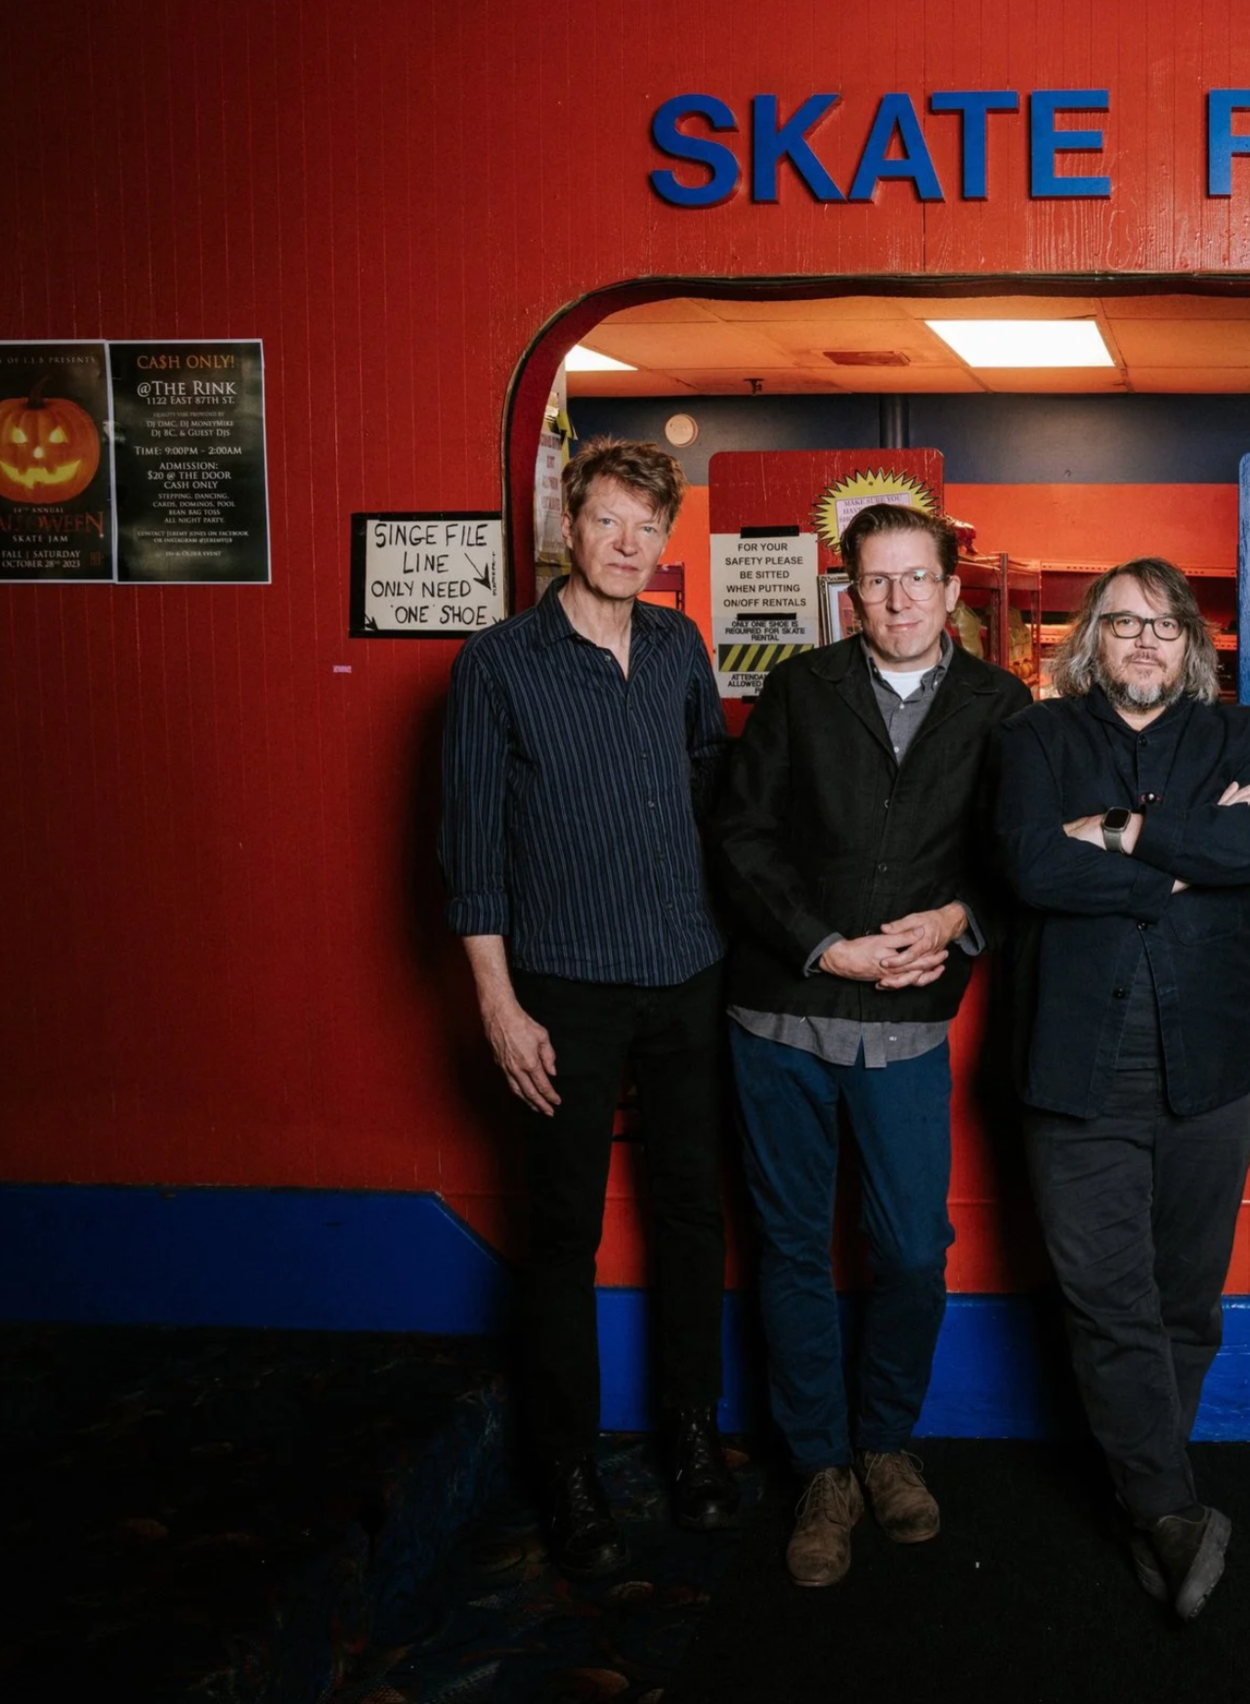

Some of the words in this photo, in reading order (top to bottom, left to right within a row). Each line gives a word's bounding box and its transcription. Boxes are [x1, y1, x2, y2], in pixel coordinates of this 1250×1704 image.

[650, 90, 1111, 207] SKATE
[49, 356, 96, 364] PRESENTS
[186, 355, 235, 369] ONLY!
[146, 396, 167, 405] 1122
[170, 396, 193, 405] EAST
[195, 396, 219, 405] 87TH
[165, 446, 199, 455] 9:00PM
[208, 446, 242, 455] 2:00AM
[160, 462, 219, 470] ADMISSION:
[148, 470, 164, 480] $20
[179, 470, 198, 480] THE
[202, 470, 232, 480] DOOR
[164, 481, 190, 490] CASH
[192, 481, 219, 490] ONLY
[0, 511, 105, 535] ALLOWEEN
[12, 535, 42, 544] SKATE
[48, 535, 69, 544] JAM
[374, 524, 438, 547] SINGE
[446, 524, 488, 547] FILE
[738, 543, 758, 552] FOR
[760, 543, 788, 552] YOUR
[2, 550, 22, 558] FALL
[33, 550, 81, 558] SATURDAY
[2, 560, 43, 568] OCTOBER
[62, 560, 81, 568] 2023
[404, 552, 449, 574] LINE
[725, 558, 762, 566] SAFETY
[766, 556, 804, 565] PLEASE
[740, 571, 753, 579] BE
[756, 571, 790, 579] SITTED
[371, 580, 414, 598] ONLY
[422, 580, 471, 598] NEED
[726, 585, 756, 593] WHEN
[758, 584, 800, 592] PUTTING
[724, 599, 760, 607] ON/OFF
[762, 598, 806, 606] RENTALS
[440, 605, 488, 625] SHOE
